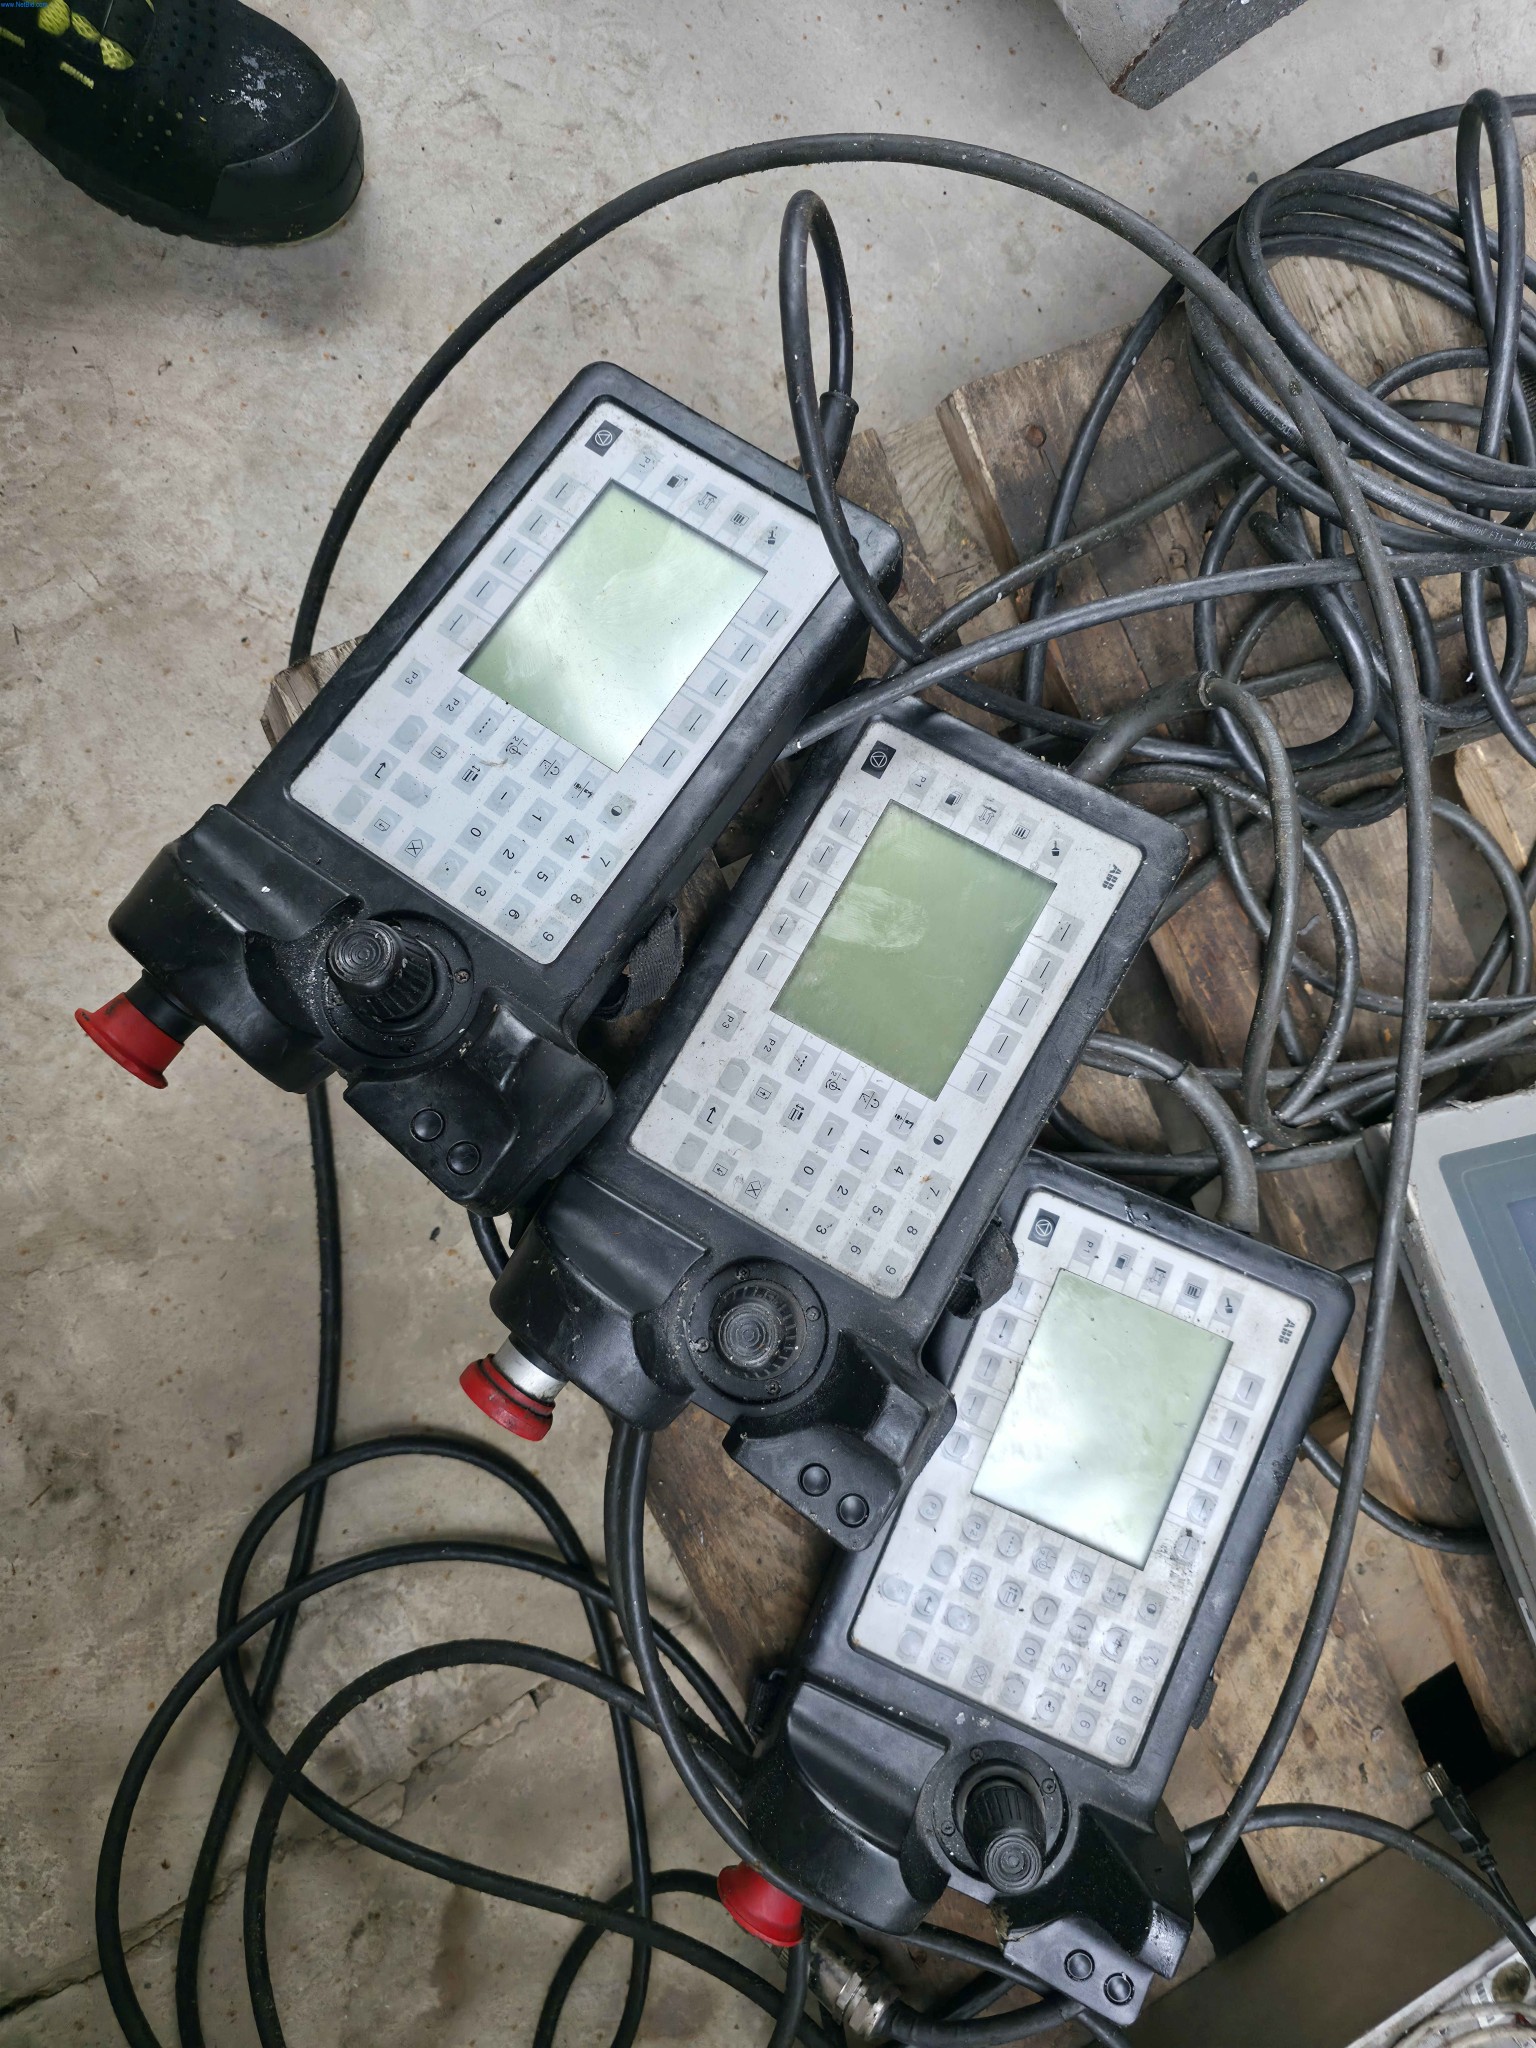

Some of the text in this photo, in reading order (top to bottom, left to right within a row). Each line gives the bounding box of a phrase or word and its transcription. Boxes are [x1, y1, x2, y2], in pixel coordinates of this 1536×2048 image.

[404, 671, 419, 685] P3
[445, 697, 460, 712] P2
[914, 776, 927, 788] P1
[470, 827, 482, 838] 0
[564, 834, 575, 845] 4
[502, 848, 515, 860] 2
[599, 856, 611, 868] 7
[536, 871, 549, 883] 5
[1102, 864, 1122, 891] ABB
[474, 886, 487, 897] 3
[570, 893, 583, 904] 8
[508, 908, 520, 920] 6
[542, 931, 555, 942] 9
[721, 1014, 735, 1029] P3
[763, 1038, 776, 1053] P2
[803, 1165, 815, 1176] 0
[893, 1165, 904, 1176] 4
[836, 1184, 849, 1196] 2
[929, 1186, 940, 1197] 7
[871, 1205, 884, 1216] 5
[815, 1224, 827, 1235] 3
[906, 1225, 919, 1236] 8
[850, 1244, 862, 1255] 6
[885, 1265, 897, 1275] 9
[1278, 1317, 1296, 1345] ABB
[969, 1520, 982, 1537] P2
[1024, 1647, 1036, 1656] 0
[1148, 1656, 1160, 1667] 7
[1060, 1662, 1072, 1673] 2
[1131, 1695, 1143, 1705] 8
[1079, 1719, 1091, 1729] 6
[1115, 1735, 1127, 1746] 9
